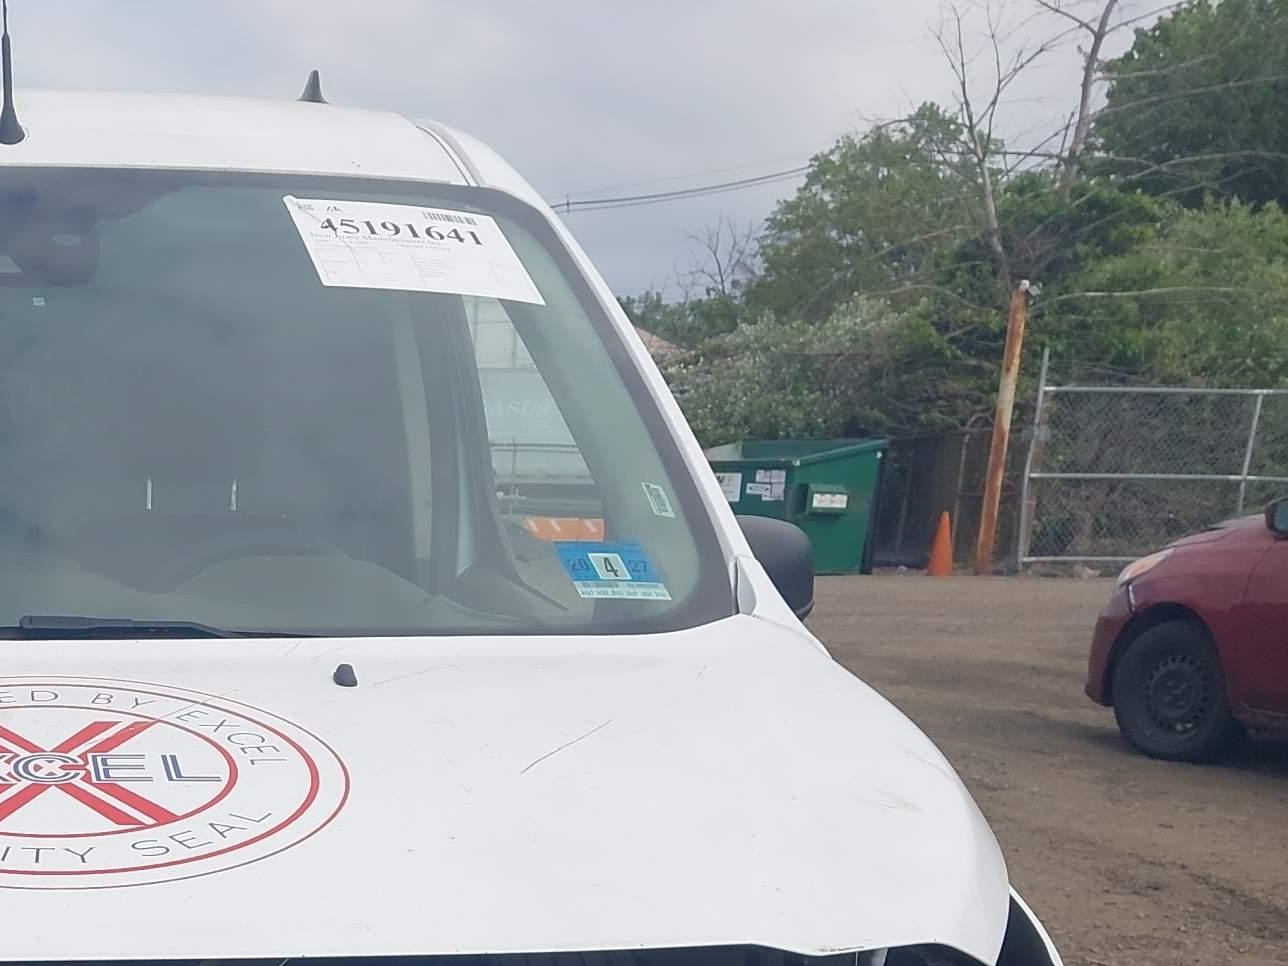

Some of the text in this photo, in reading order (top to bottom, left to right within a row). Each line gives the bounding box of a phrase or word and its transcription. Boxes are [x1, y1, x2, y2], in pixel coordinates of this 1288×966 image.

[320, 217, 483, 246] 45191641
[603, 557, 619, 577] 4
[91, 692, 159, 711] BY
[176, 708, 288, 767] EXCEL
[129, 807, 274, 859] SEAL
